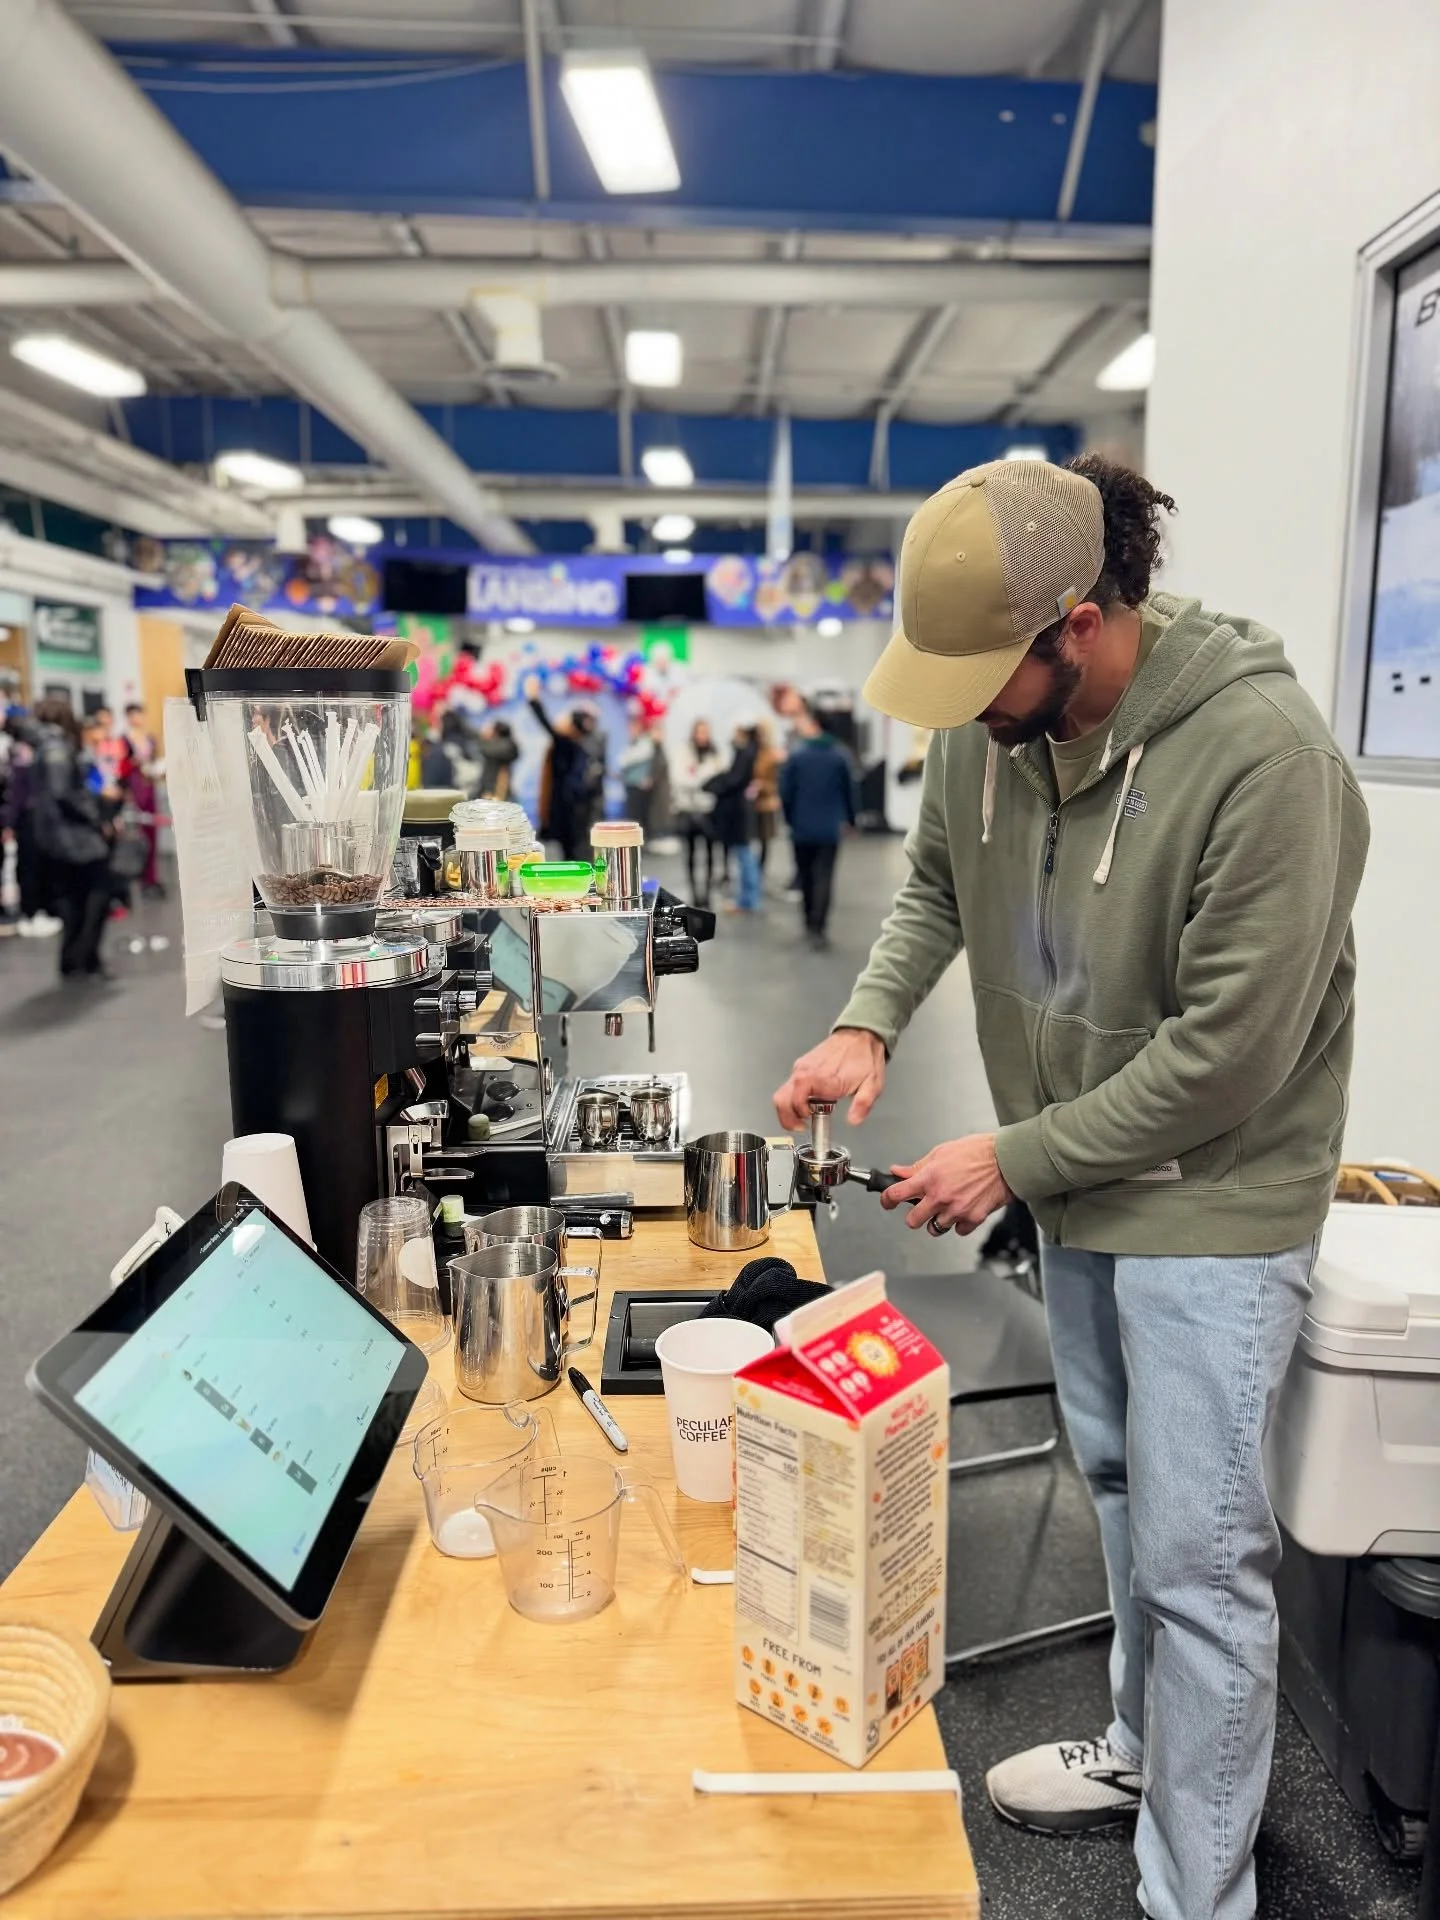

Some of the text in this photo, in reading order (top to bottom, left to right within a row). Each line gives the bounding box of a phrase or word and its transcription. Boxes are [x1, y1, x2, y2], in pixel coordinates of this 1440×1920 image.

[679, 1428, 727, 1443] COFFEE
[737, 1405, 772, 1428] Nutrition
[774, 1421, 798, 1438] Facts
[763, 1637, 789, 1661] FREE
[792, 1652, 822, 1678] FROM
